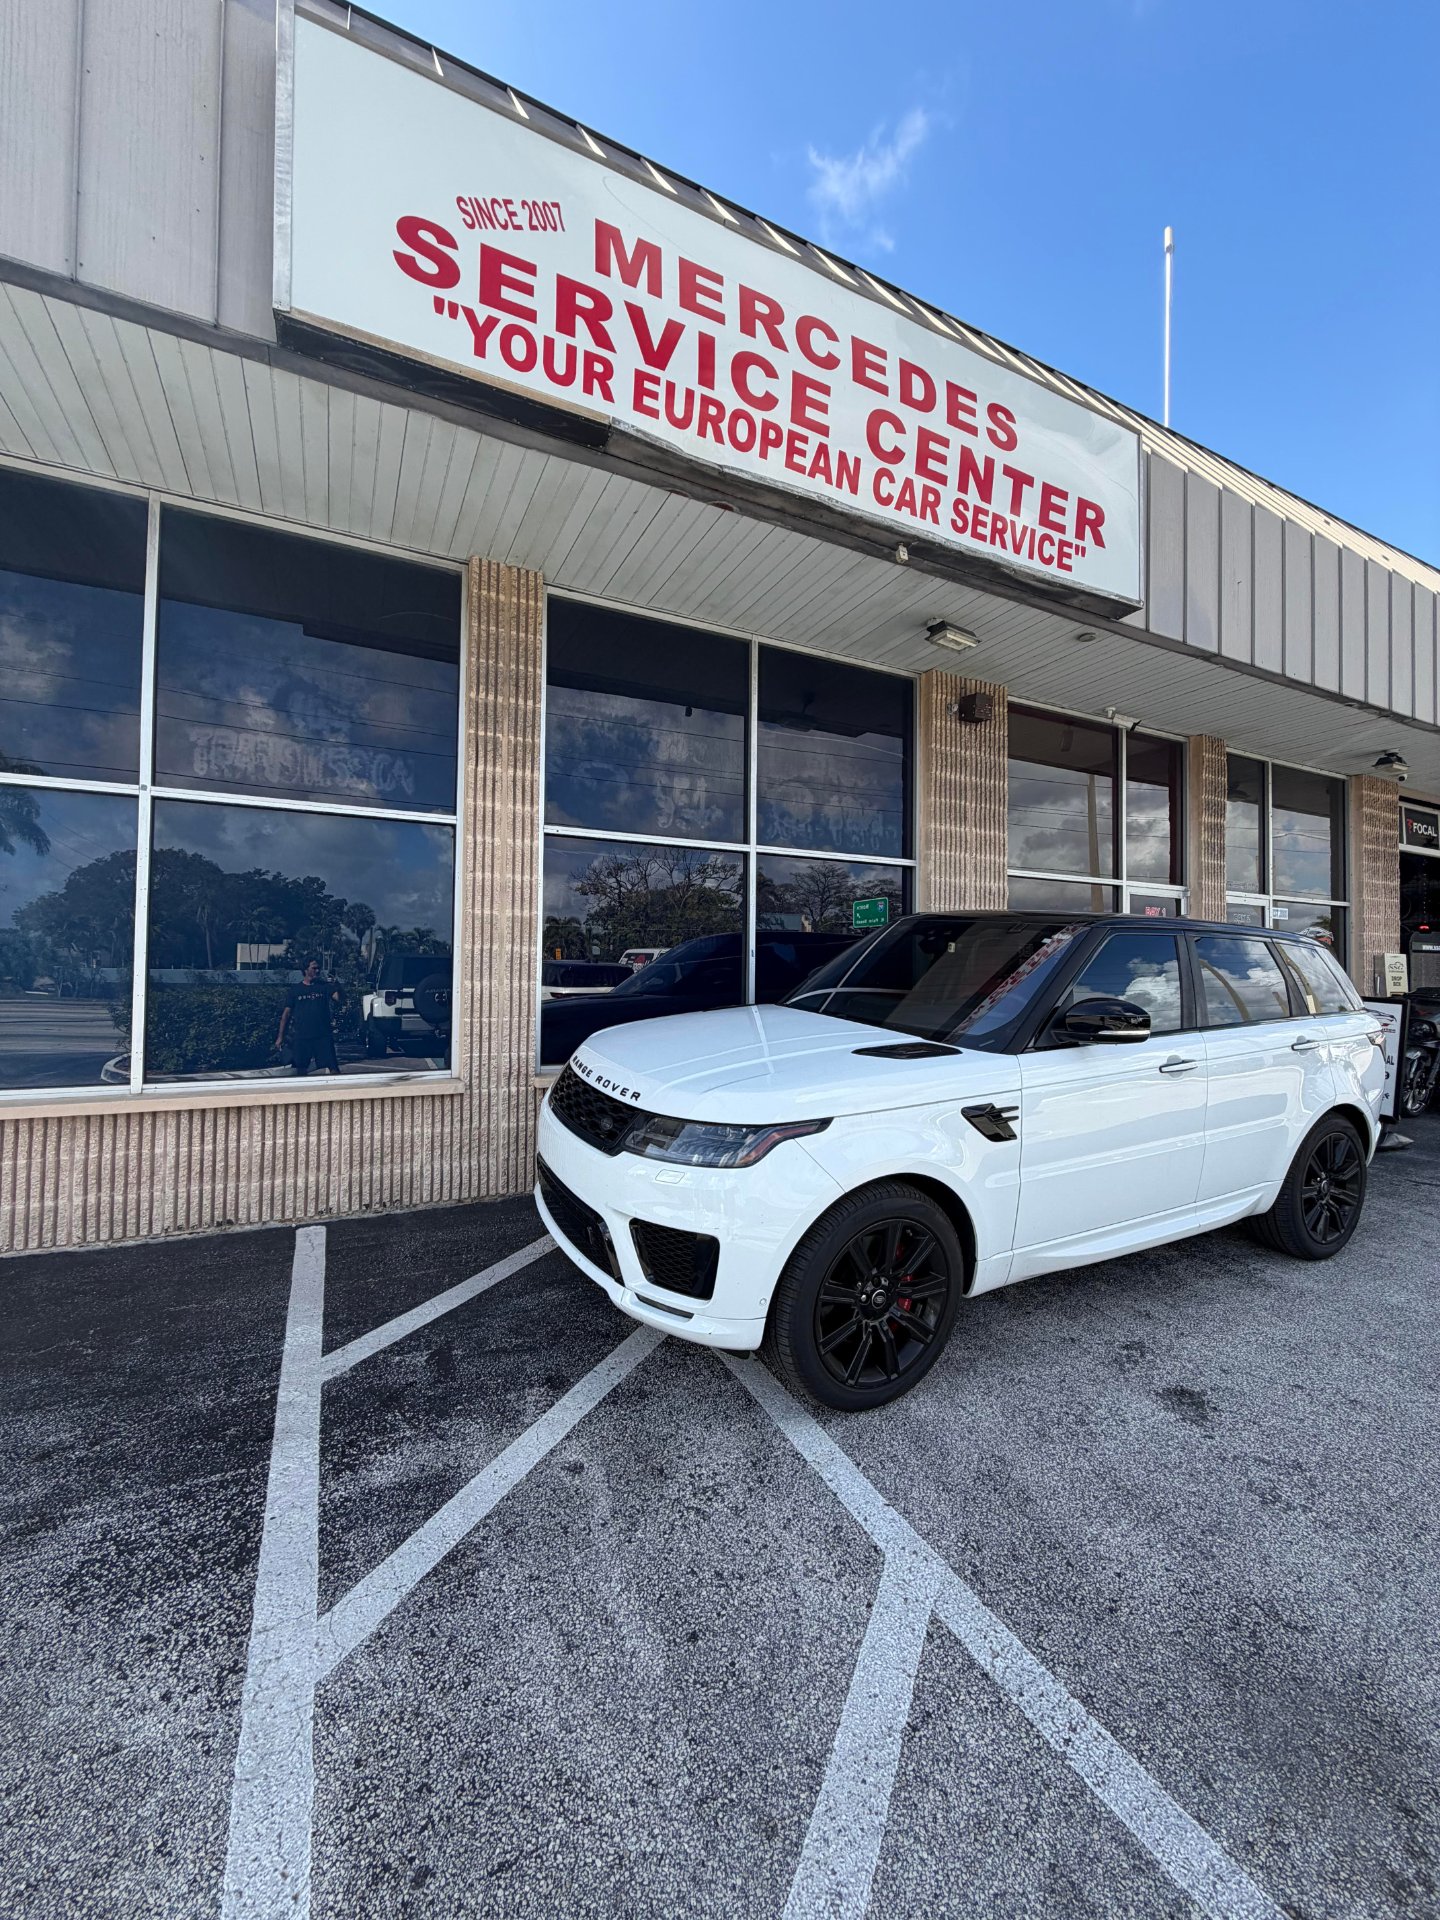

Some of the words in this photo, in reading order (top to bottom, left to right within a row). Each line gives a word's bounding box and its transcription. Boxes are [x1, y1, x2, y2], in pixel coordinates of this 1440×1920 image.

[456, 195, 523, 231] SINCE
[520, 201, 565, 232] 2007
[393, 215, 832, 438] SERVICE
[865, 409, 1105, 548] CENTER
[595, 217, 1017, 452] MERCEDES
[433, 295, 615, 403] "YOUR
[633, 368, 861, 495] EUROPEAN
[873, 468, 941, 525] CAR
[951, 498, 1087, 573] SERVICE"
[1412, 822, 1438, 837] FOCAL
[572, 1055, 593, 1078] RANGE
[595, 1075, 642, 1102] ROVER
